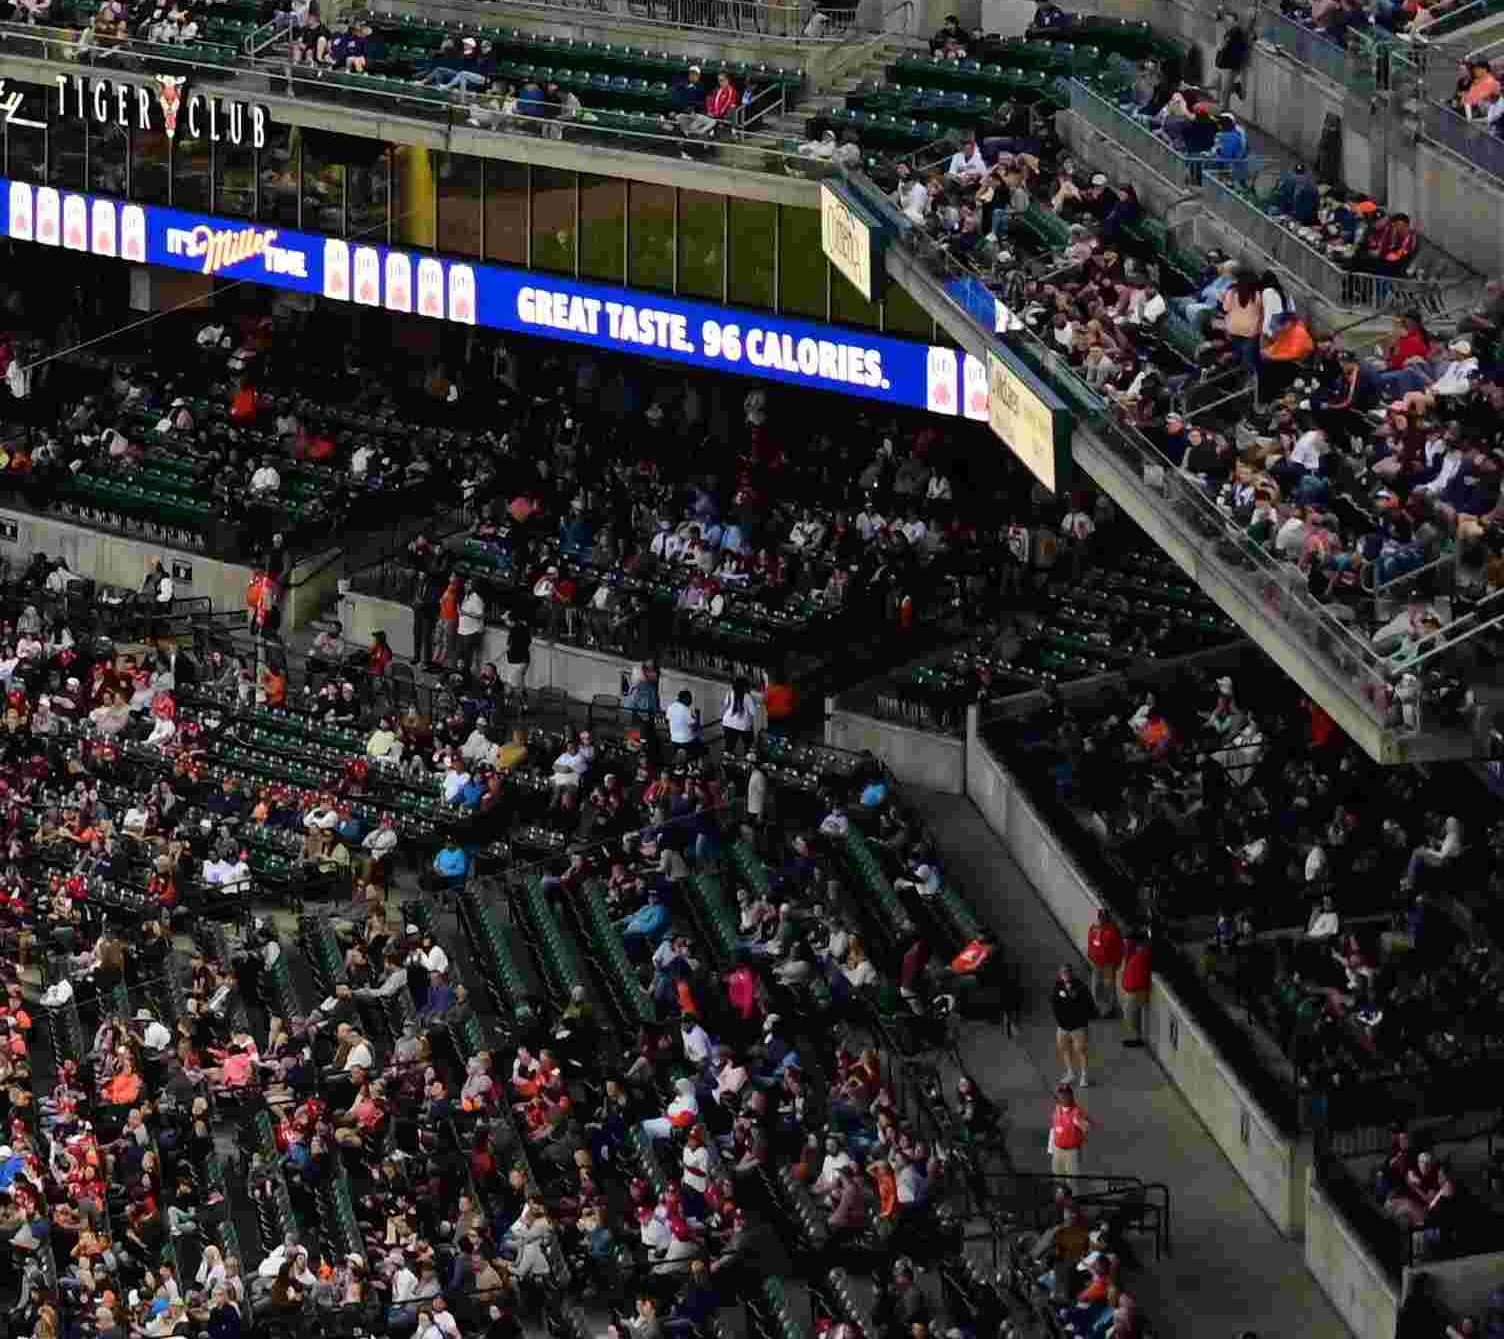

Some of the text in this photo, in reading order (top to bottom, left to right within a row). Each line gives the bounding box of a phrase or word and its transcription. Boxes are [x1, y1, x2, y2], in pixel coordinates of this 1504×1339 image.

[55, 75, 265, 148] TIGER CLUB
[517, 286, 601, 333] GREAT
[702, 319, 742, 360] 96
[746, 327, 890, 391] CALORIES.
